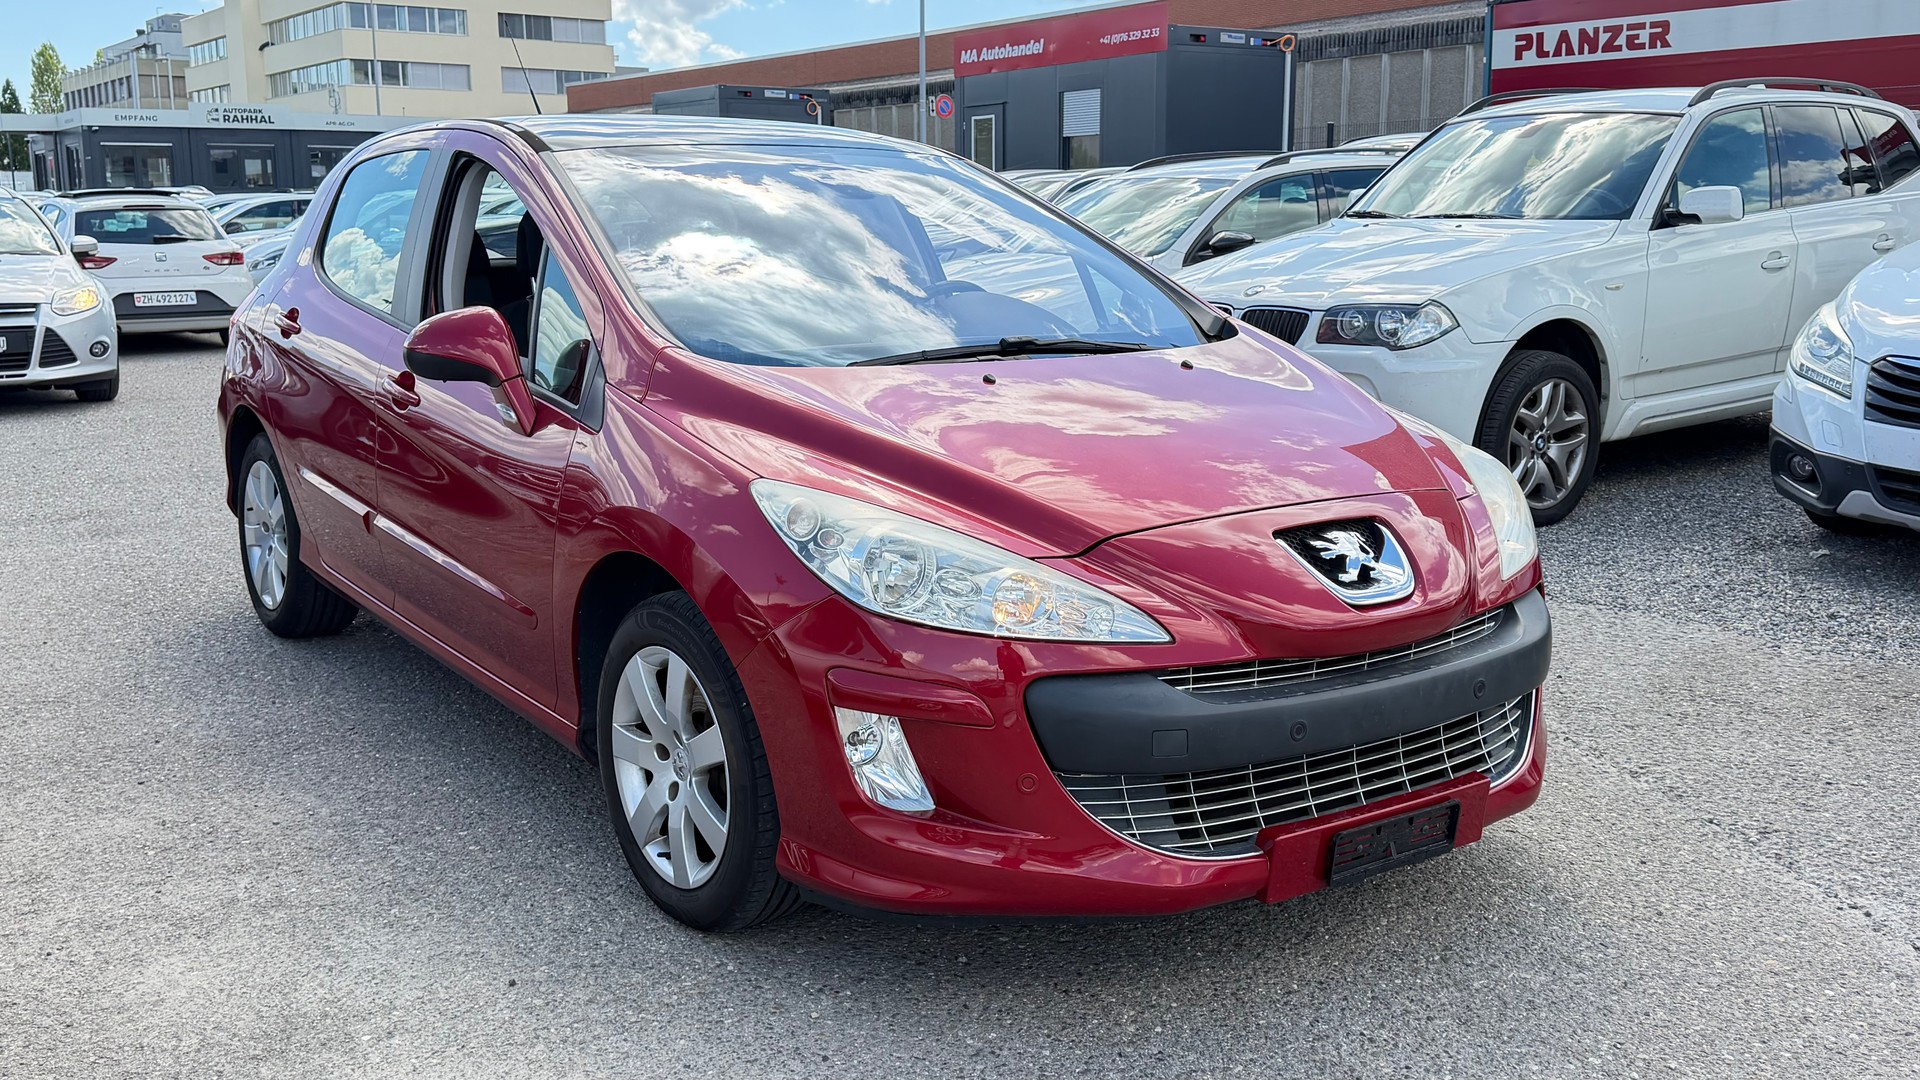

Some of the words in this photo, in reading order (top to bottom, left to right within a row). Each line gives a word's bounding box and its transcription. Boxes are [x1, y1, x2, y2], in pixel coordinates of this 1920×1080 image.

[1100, 35, 1110, 44] +41
[1128, 30, 1142, 40] 329
[1142, 29, 1150, 39] 32
[1151, 27, 1160, 37] 33
[1514, 19, 1672, 61] PLANZER
[960, 49, 978, 64] MA
[979, 38, 1044, 61] Autohandel
[222, 107, 264, 115] AUTOPARK
[114, 114, 159, 122] EMPFANG
[222, 114, 275, 124] RAHHAL
